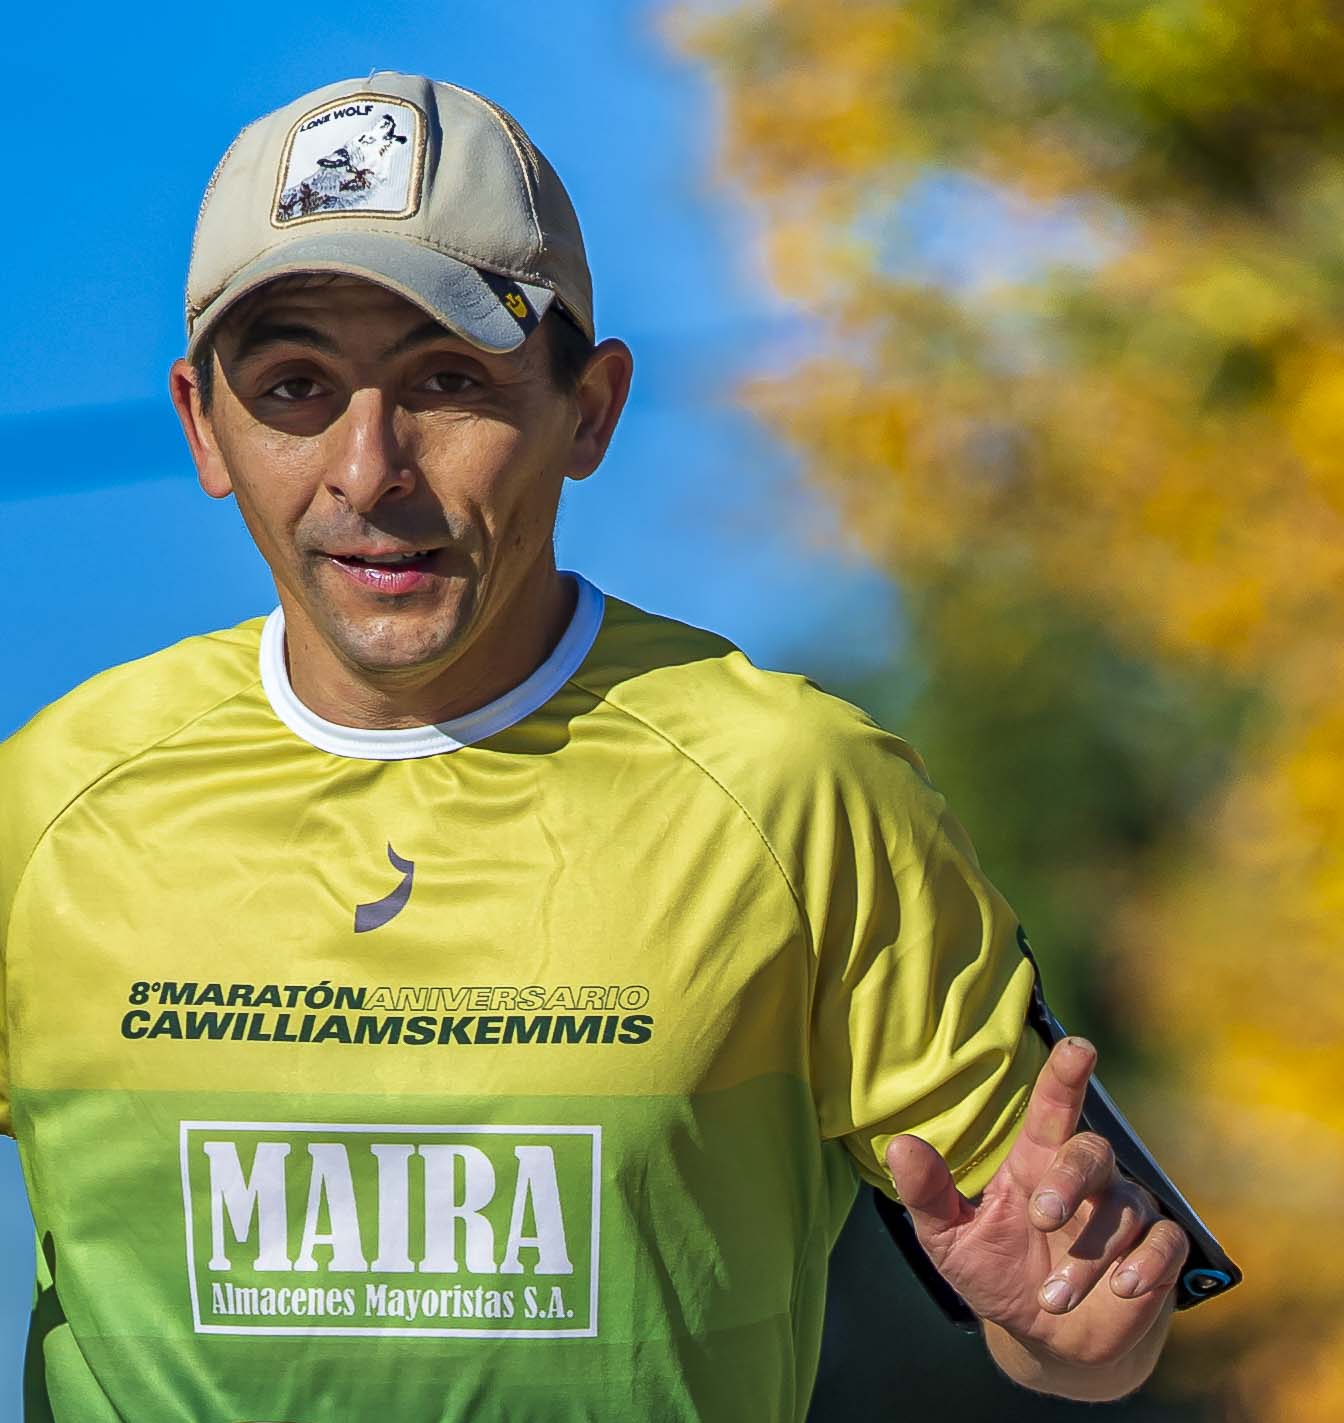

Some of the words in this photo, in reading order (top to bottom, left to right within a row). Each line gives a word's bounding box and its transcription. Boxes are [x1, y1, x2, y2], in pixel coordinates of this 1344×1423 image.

[300, 114, 331, 132] LONE
[334, 105, 374, 119] WOLF
[120, 1009, 654, 1046] CAWILLIAMSKEMMIS
[203, 1141, 574, 1274] MAIRA
[211, 1282, 356, 1317] Almacenes
[365, 1283, 515, 1321] Mayoristas
[524, 1286, 575, 1319] S.A.
